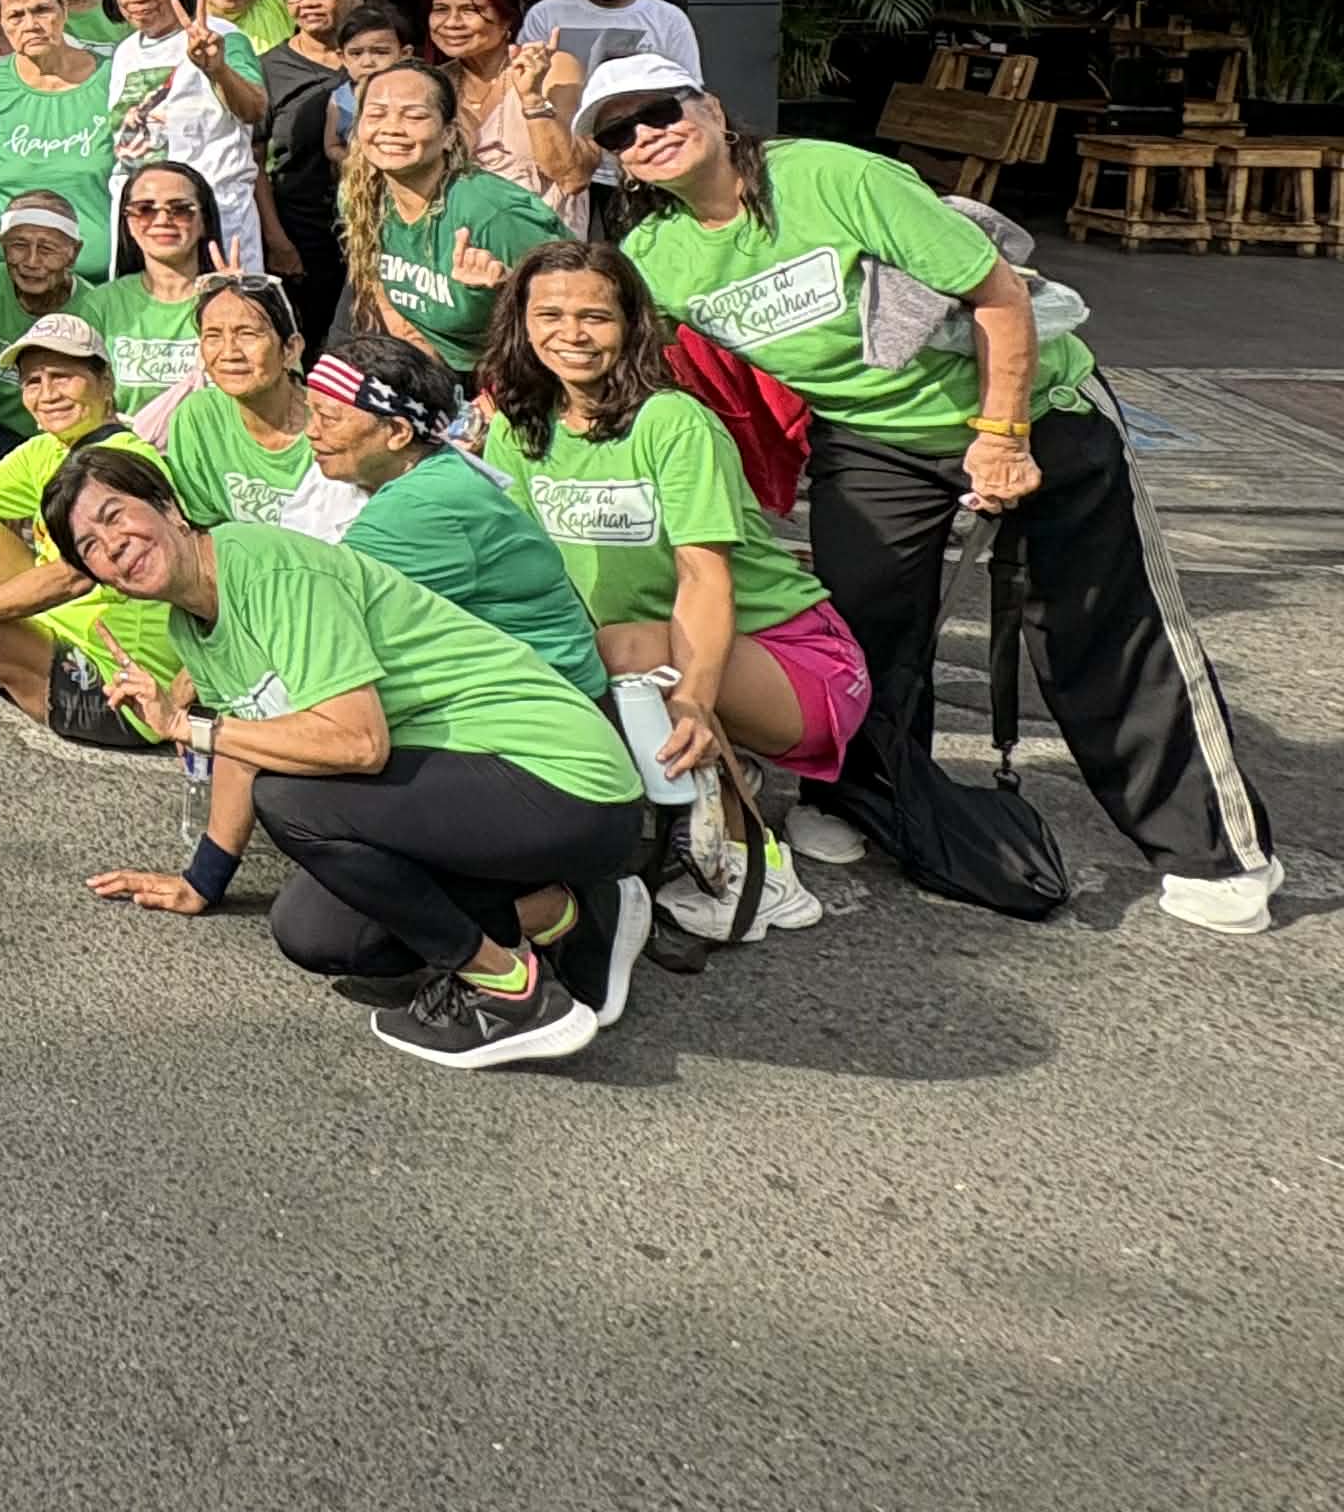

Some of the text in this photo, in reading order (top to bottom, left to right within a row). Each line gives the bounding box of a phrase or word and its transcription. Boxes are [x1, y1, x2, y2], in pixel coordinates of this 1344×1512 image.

[3, 123, 95, 159] happy
[690, 283, 768, 325] Zumba
[772, 271, 795, 293] at
[722, 287, 820, 337] Kapihan
[534, 480, 617, 506] Zumba at
[546, 504, 633, 537] Kapihan
